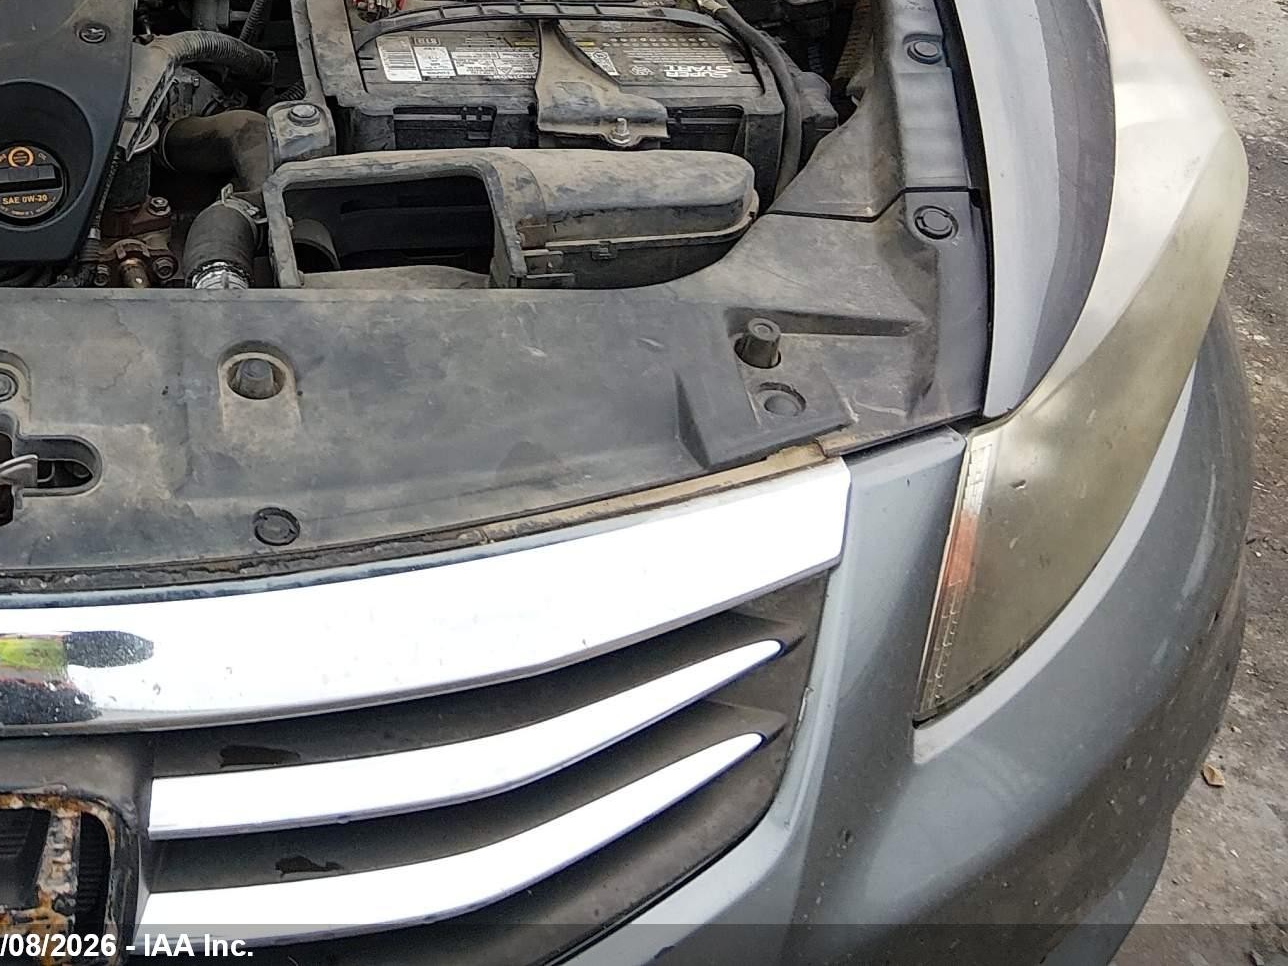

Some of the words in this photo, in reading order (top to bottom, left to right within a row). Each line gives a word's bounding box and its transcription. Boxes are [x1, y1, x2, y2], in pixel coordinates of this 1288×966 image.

[663, 64, 733, 73] START
[665, 71, 729, 79] SUPER
[2, 195, 20, 205] SAE
[21, 193, 49, 204] 0W-20
